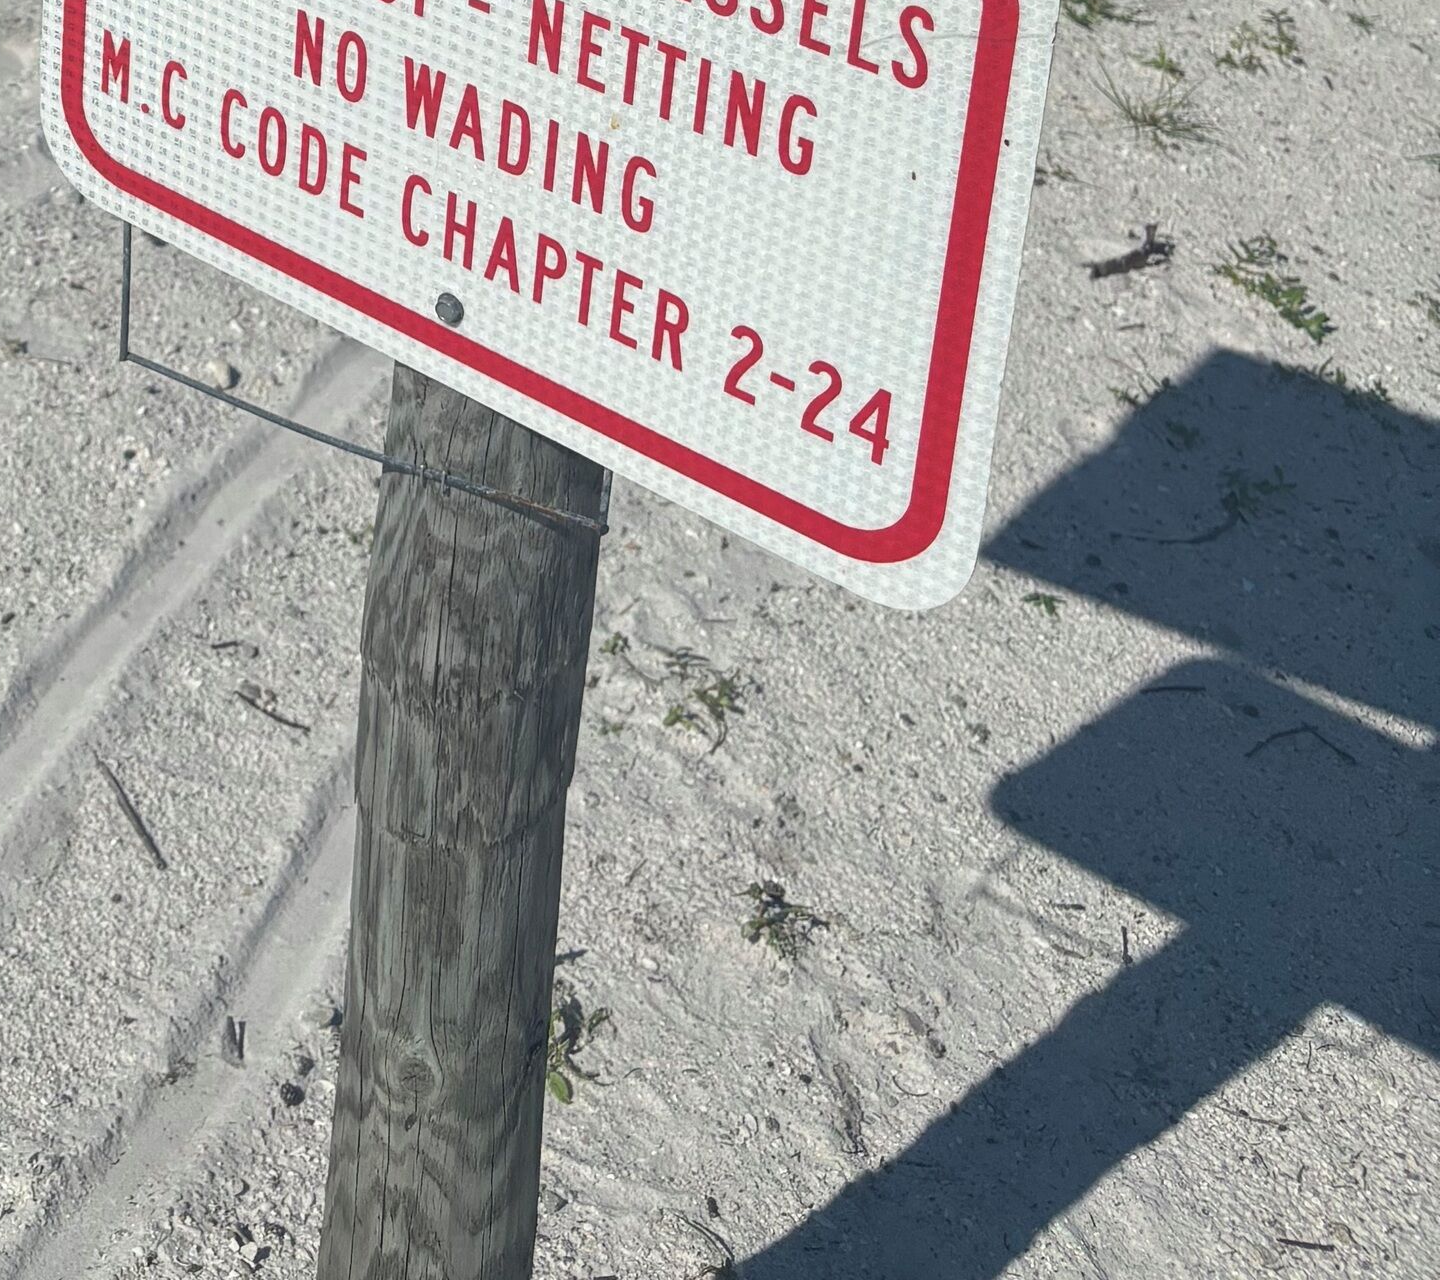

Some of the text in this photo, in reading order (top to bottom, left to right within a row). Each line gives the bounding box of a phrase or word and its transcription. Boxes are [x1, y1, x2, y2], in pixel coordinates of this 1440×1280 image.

[102, 32, 891, 464] M.C CODE CHAPTER 2-24
[295, 12, 655, 233] NO WADING
